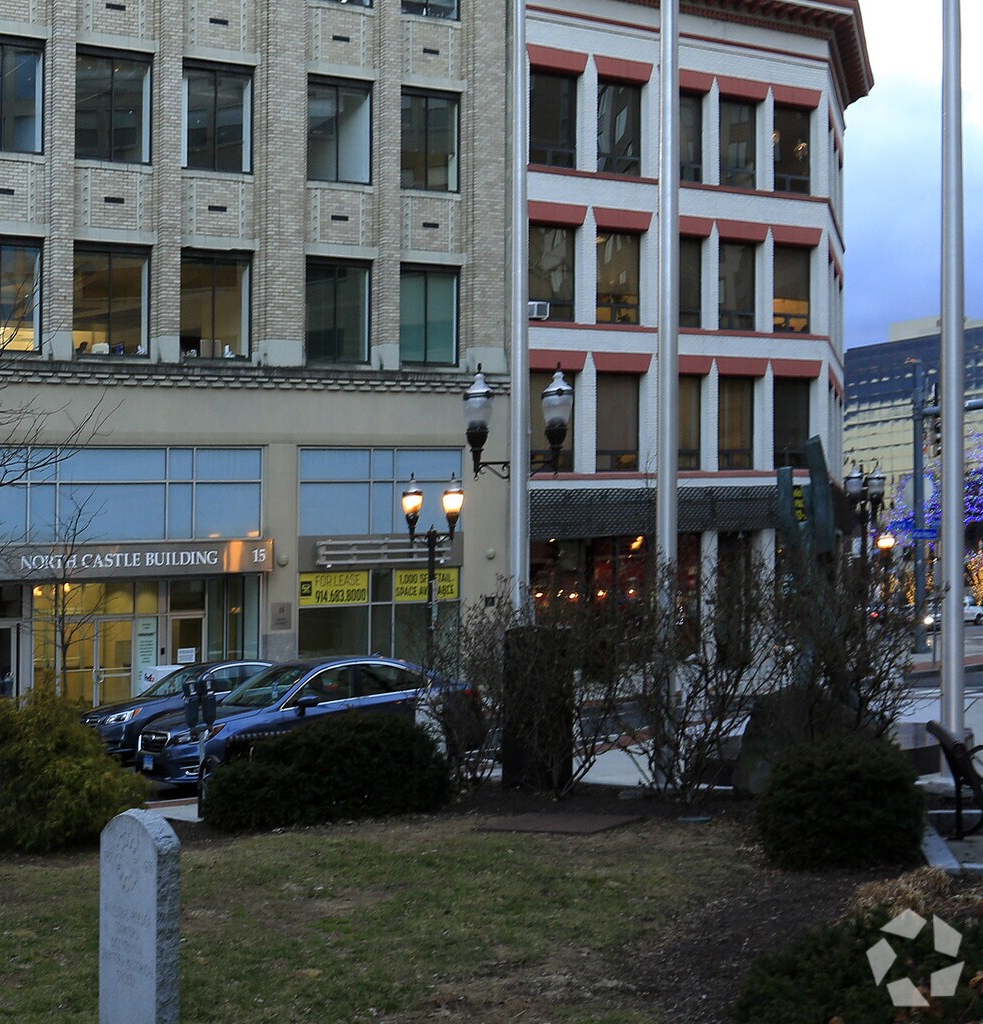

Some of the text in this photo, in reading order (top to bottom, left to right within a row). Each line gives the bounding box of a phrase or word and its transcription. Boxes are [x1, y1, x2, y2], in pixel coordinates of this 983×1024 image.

[20, 550, 218, 570] NORTH CASTLE BUILDING
[252, 548, 266, 563] 15
[315, 573, 361, 587] FOR LEASE
[395, 585, 418, 597] SPACE
